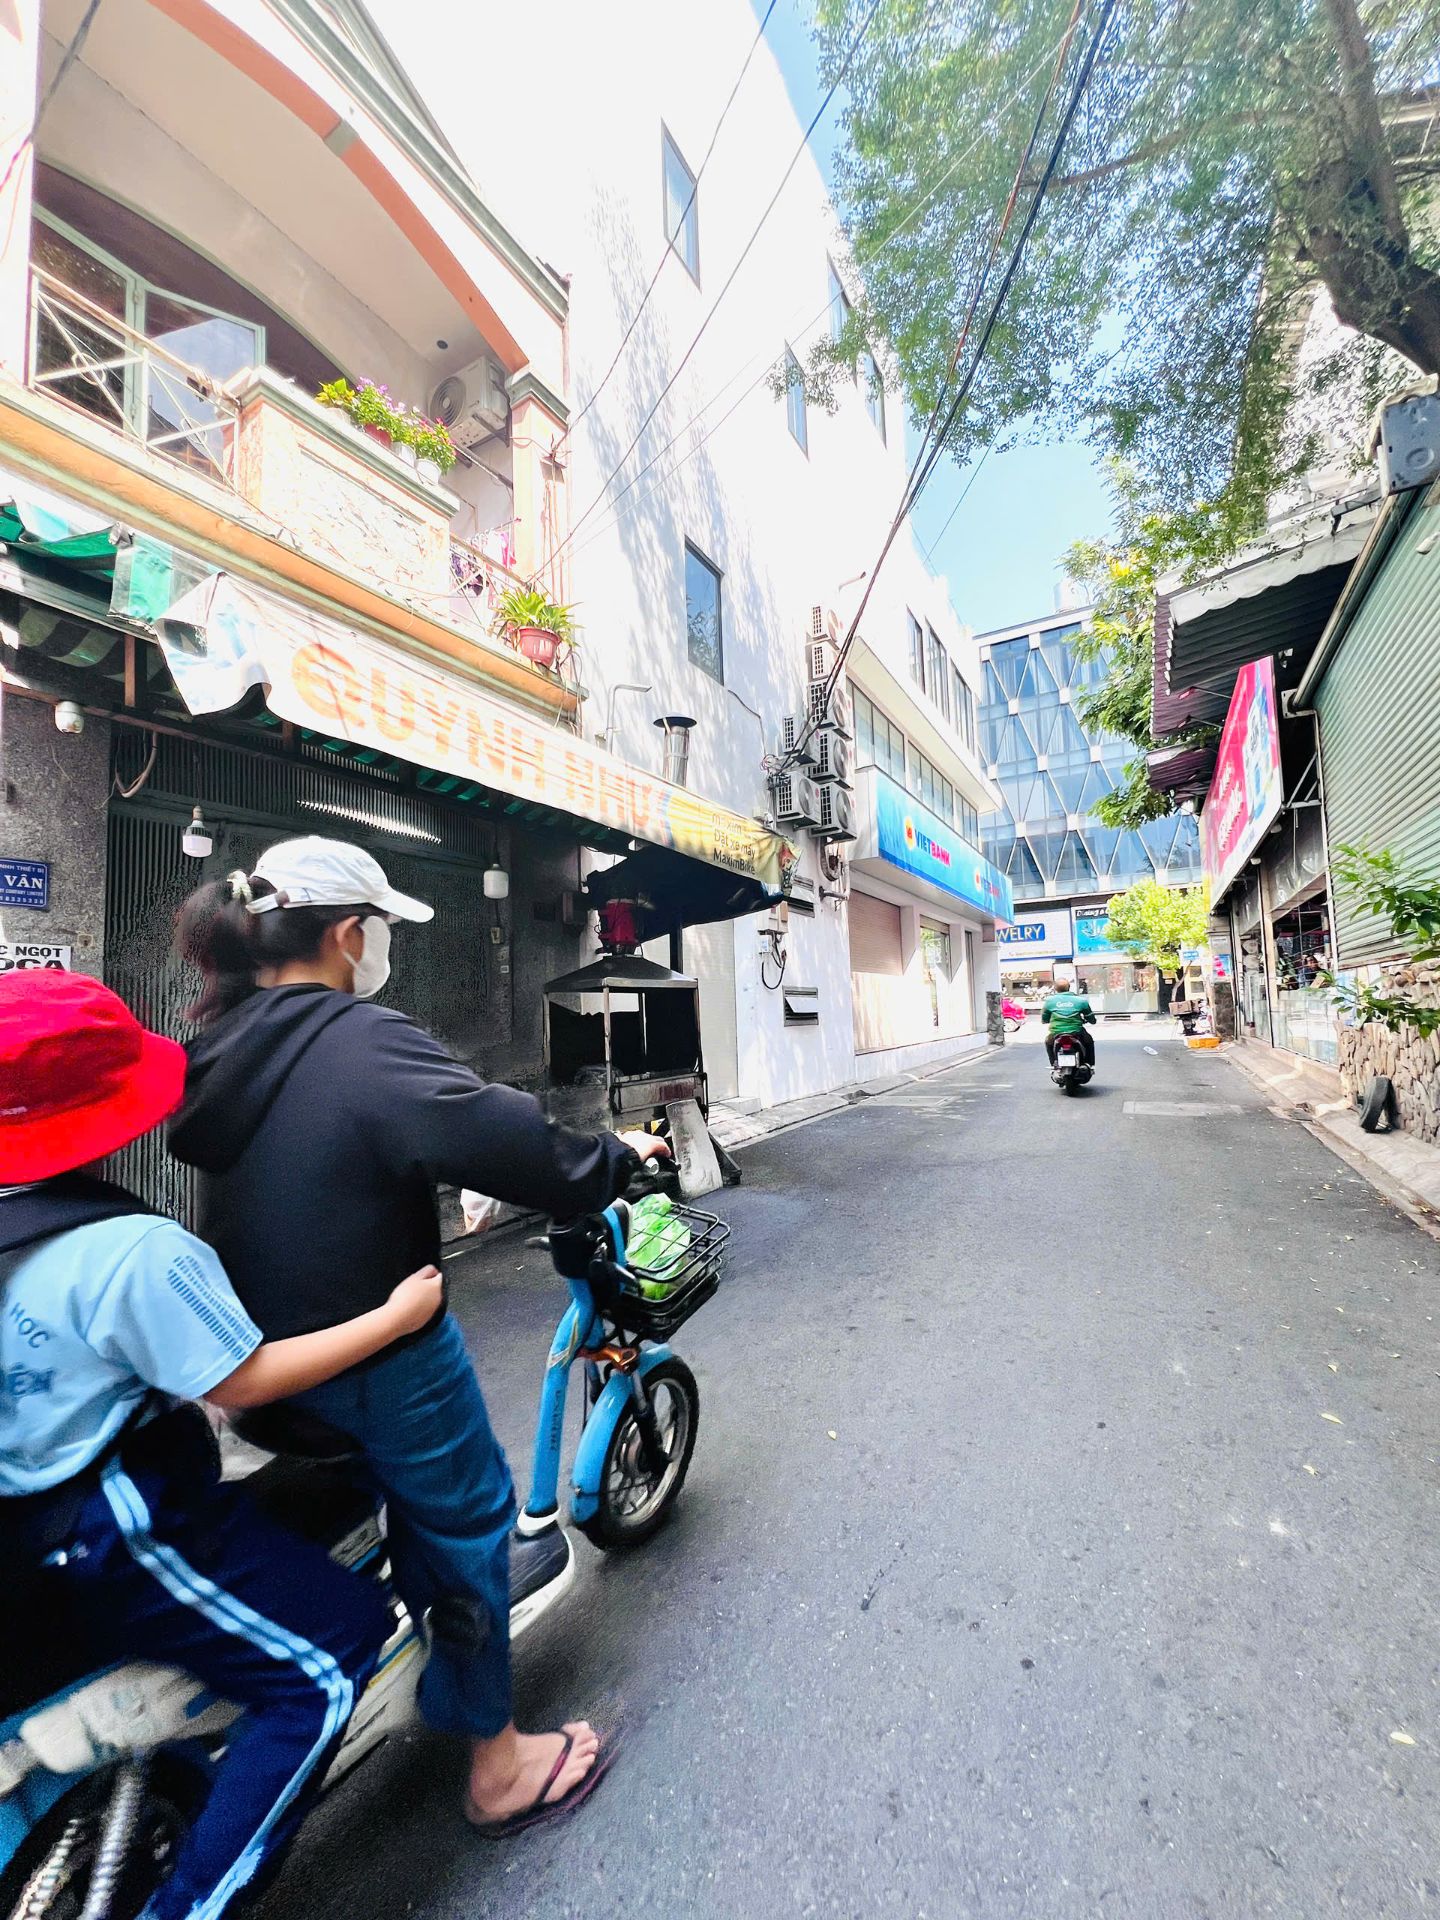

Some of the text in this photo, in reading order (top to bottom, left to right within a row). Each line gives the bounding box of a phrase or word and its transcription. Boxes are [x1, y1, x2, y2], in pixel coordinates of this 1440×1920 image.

[914, 829, 951, 867] VIETBANK
[713, 847, 756, 875] MaximBike
[4, 873, 44, 889] VÂN
[15, 946, 63, 959] NGỌT
